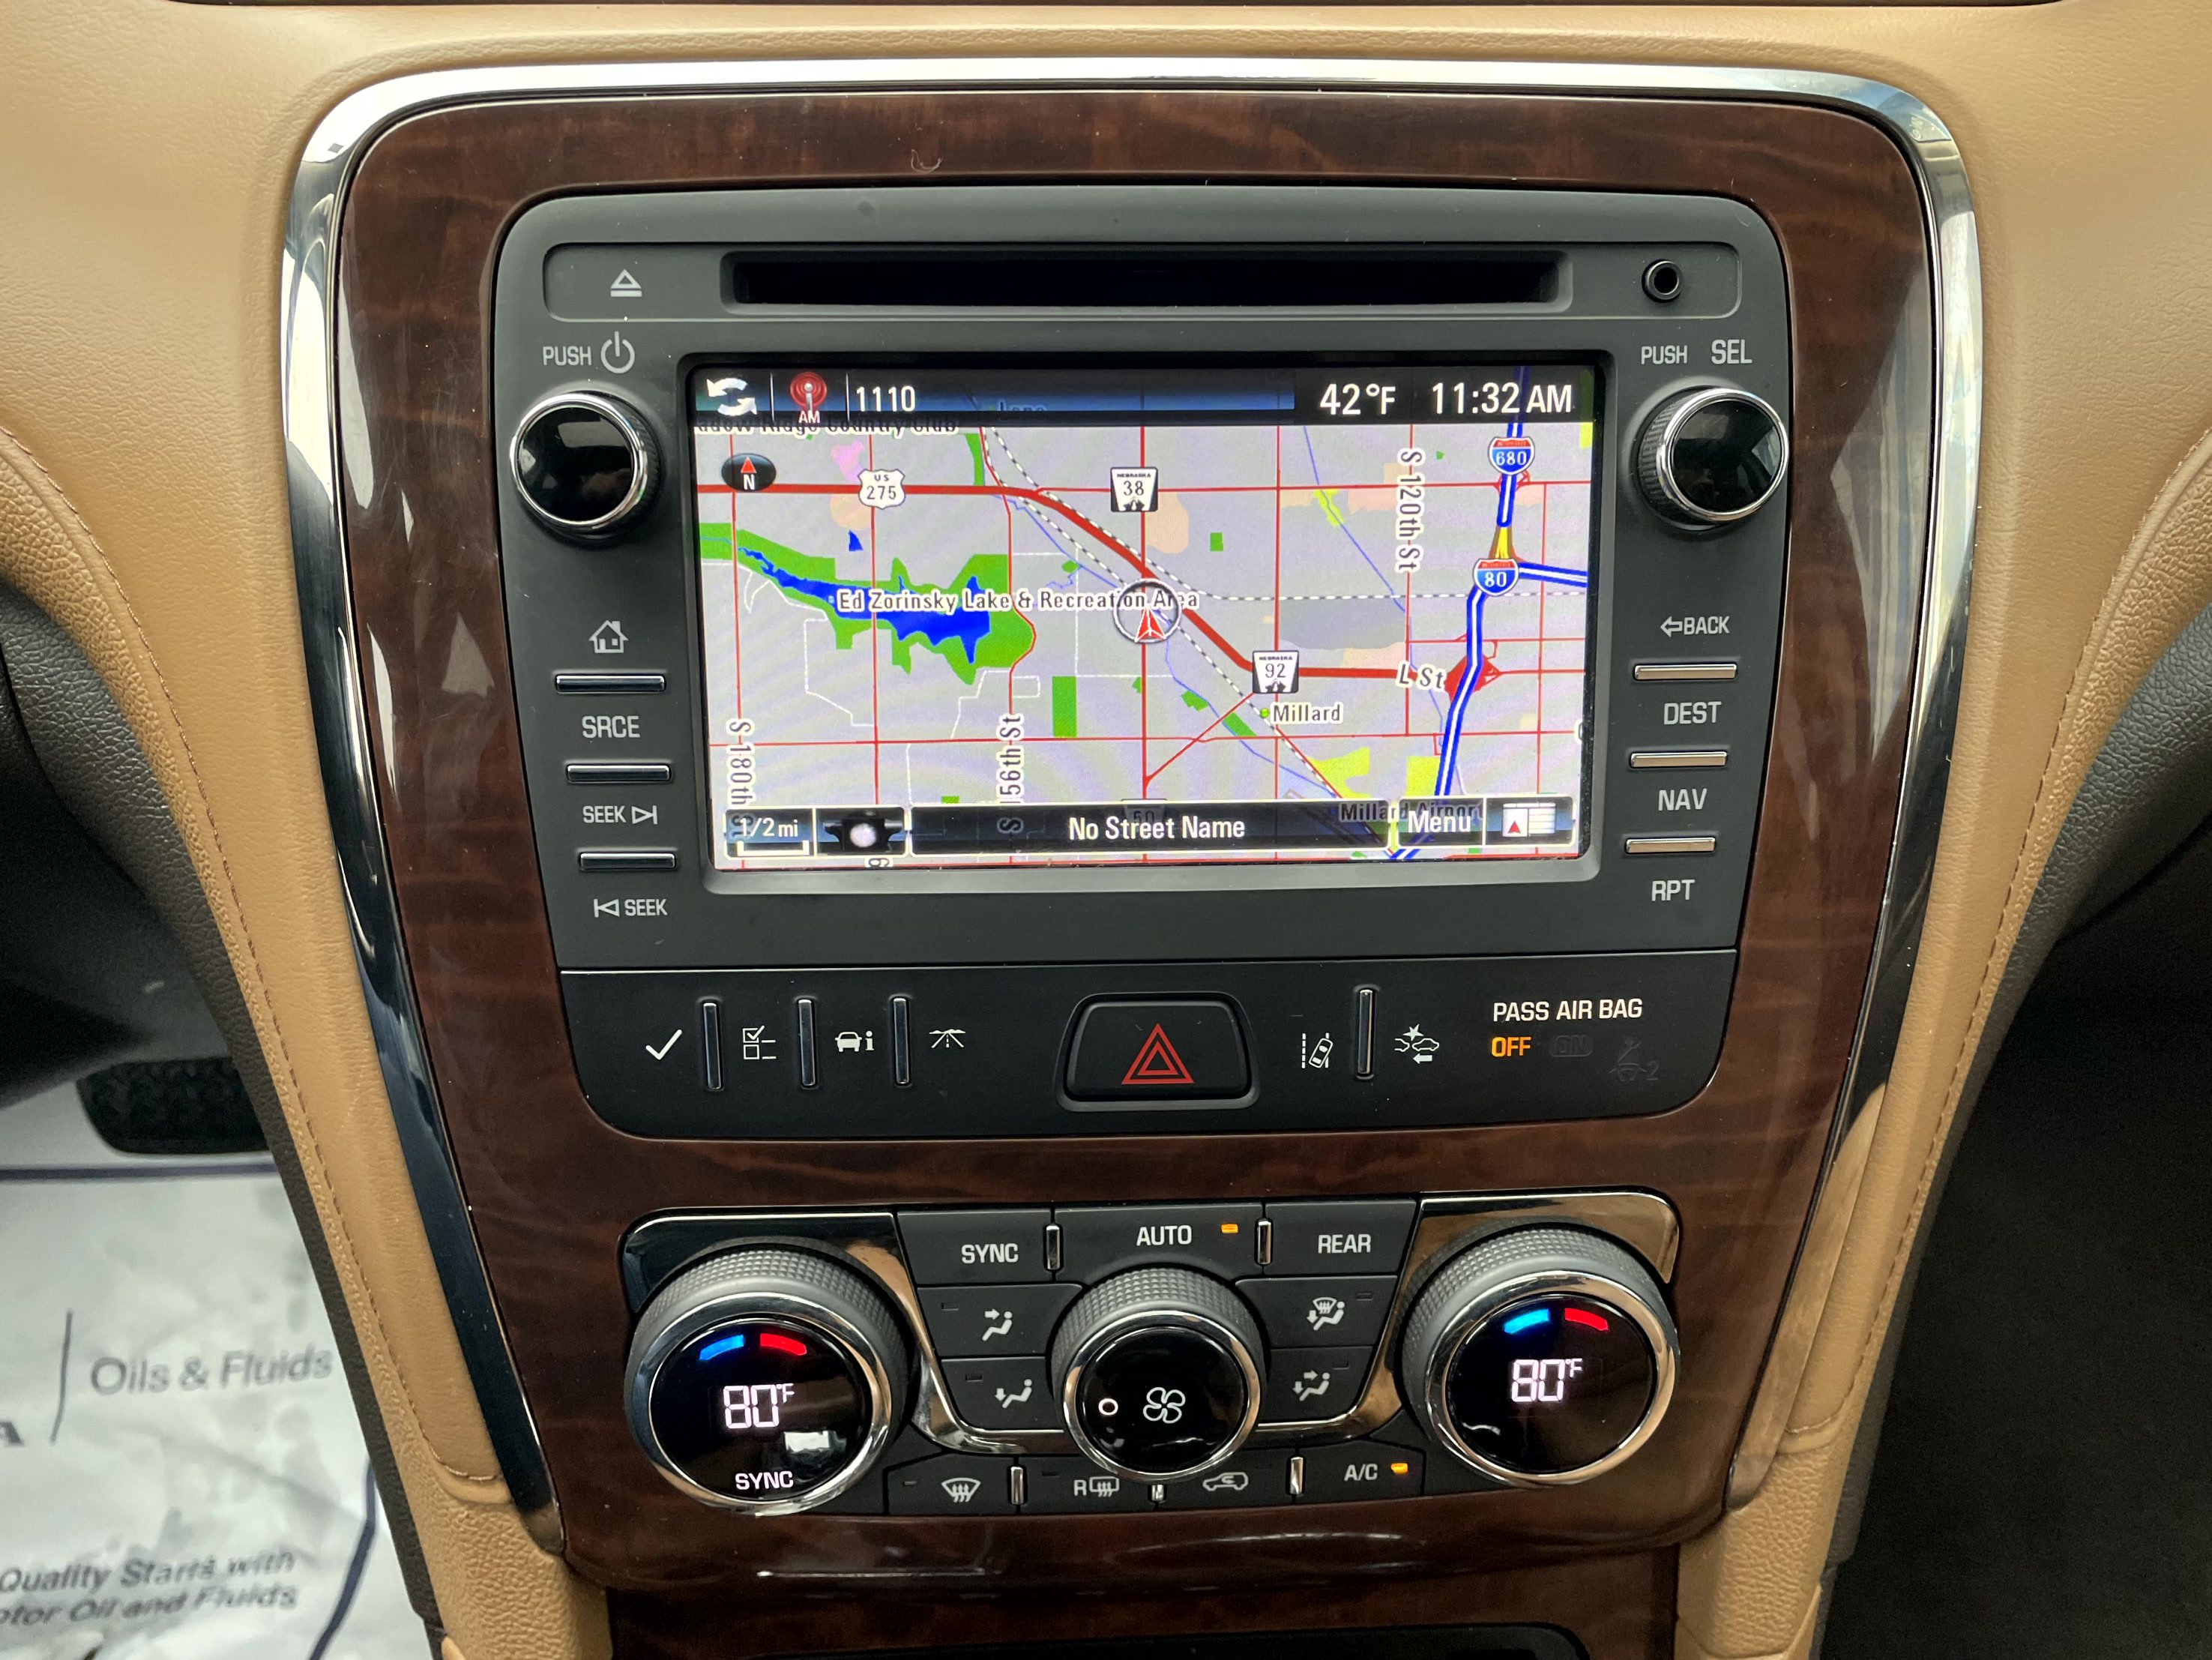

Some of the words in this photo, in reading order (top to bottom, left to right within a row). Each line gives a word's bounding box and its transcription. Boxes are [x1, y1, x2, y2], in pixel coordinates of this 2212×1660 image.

[543, 346, 592, 366] PUSH
[1641, 345, 1687, 364] PUSH
[1711, 339, 1753, 364] SEL
[856, 385, 916, 412] 1110
[1320, 383, 1396, 415] 42°F
[1432, 382, 1519, 414] 11:32
[1526, 385, 1572, 413] AM
[798, 411, 820, 424] AM
[1400, 451, 1423, 463] S
[1495, 451, 1527, 466] 680
[744, 475, 755, 490] N
[1123, 481, 1145, 496] 38
[867, 487, 896, 500] 275
[1399, 475, 1422, 537] 120th
[1398, 547, 1420, 570] St
[1485, 571, 1507, 588] 80
[840, 592, 862, 609] Ed
[871, 592, 956, 612] Zorinsky
[965, 591, 1010, 609] Lake
[1017, 591, 1031, 609] &
[1684, 616, 1729, 635] BACK
[1265, 663, 1286, 679] 92
[1399, 664, 1411, 685] L
[1419, 667, 1444, 690] St
[1274, 704, 1340, 722] Millard
[1663, 701, 1722, 725] DEST
[582, 715, 640, 738] SRCE
[729, 721, 751, 733] S
[999, 715, 1022, 739] St
[730, 745, 753, 805] 180th
[1658, 788, 1708, 811] NAV
[582, 806, 626, 823] SEEK
[1408, 810, 1471, 833] Menu
[739, 817, 775, 837] 1/2
[779, 820, 798, 837] mi
[1069, 817, 1099, 840] No
[1105, 816, 1175, 840] Street
[1182, 815, 1246, 839] Name
[1651, 879, 1695, 901] RPT
[624, 899, 667, 916] SEEK
[1493, 1002, 1549, 1022] PASS
[1555, 999, 1592, 1020] AIR
[1599, 998, 1643, 1019] BAG
[1491, 1036, 1531, 1057] OFF
[1136, 1225, 1193, 1245] AUTO
[1318, 1233, 1371, 1254] REAR
[961, 1244, 1019, 1264] SYNC
[90, 1357, 172, 1395] Oils
[177, 1356, 208, 1391] &
[220, 1344, 334, 1389] Fluids
[735, 1471, 794, 1491] SYNC
[1344, 1464, 1378, 1482] A/C
[0, 1563, 111, 1594] Quality
[120, 1555, 217, 1587] Starts
[228, 1551, 295, 1575] with
[70, 1597, 120, 1623] Oil
[122, 1590, 189, 1618] and
[193, 1583, 298, 1611] Fluids
